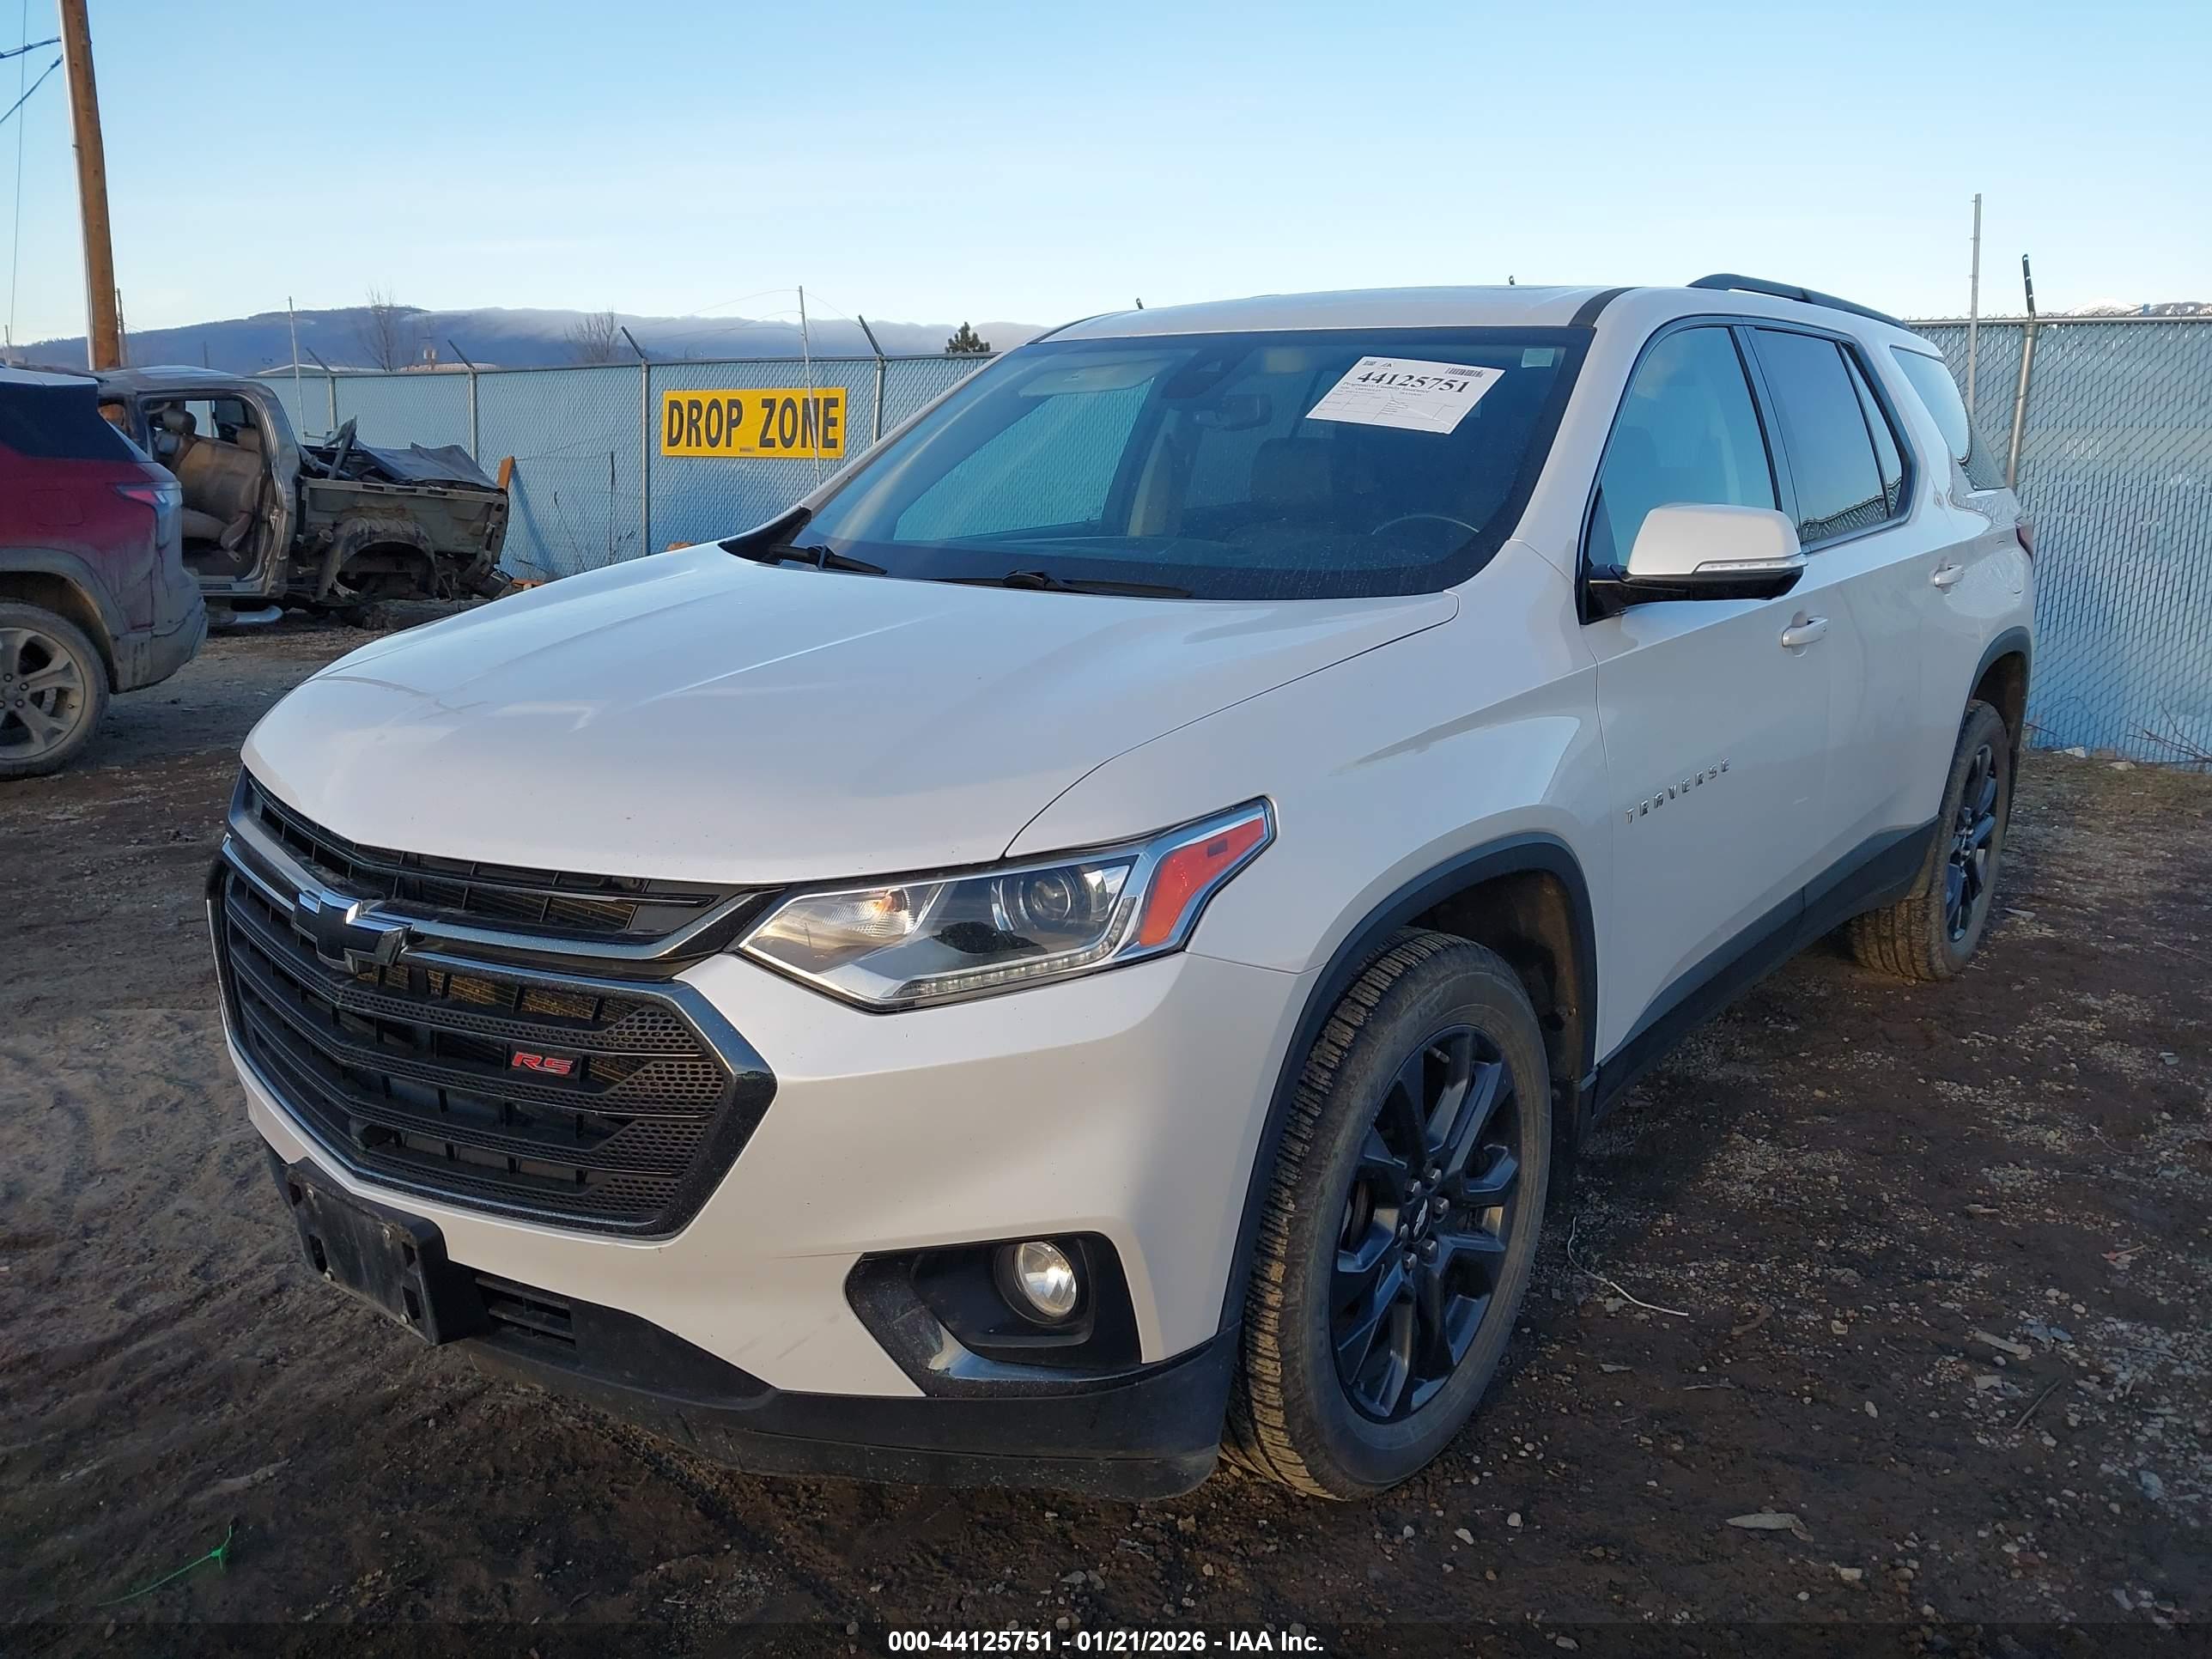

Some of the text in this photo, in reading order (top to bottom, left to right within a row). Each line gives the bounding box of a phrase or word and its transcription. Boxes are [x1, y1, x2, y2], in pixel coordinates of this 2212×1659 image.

[1357, 372, 1471, 393] 44125751
[666, 398, 840, 448] DROP ZONE
[1626, 757, 1729, 824] TRAVERSE
[512, 1051, 574, 1075] RS
